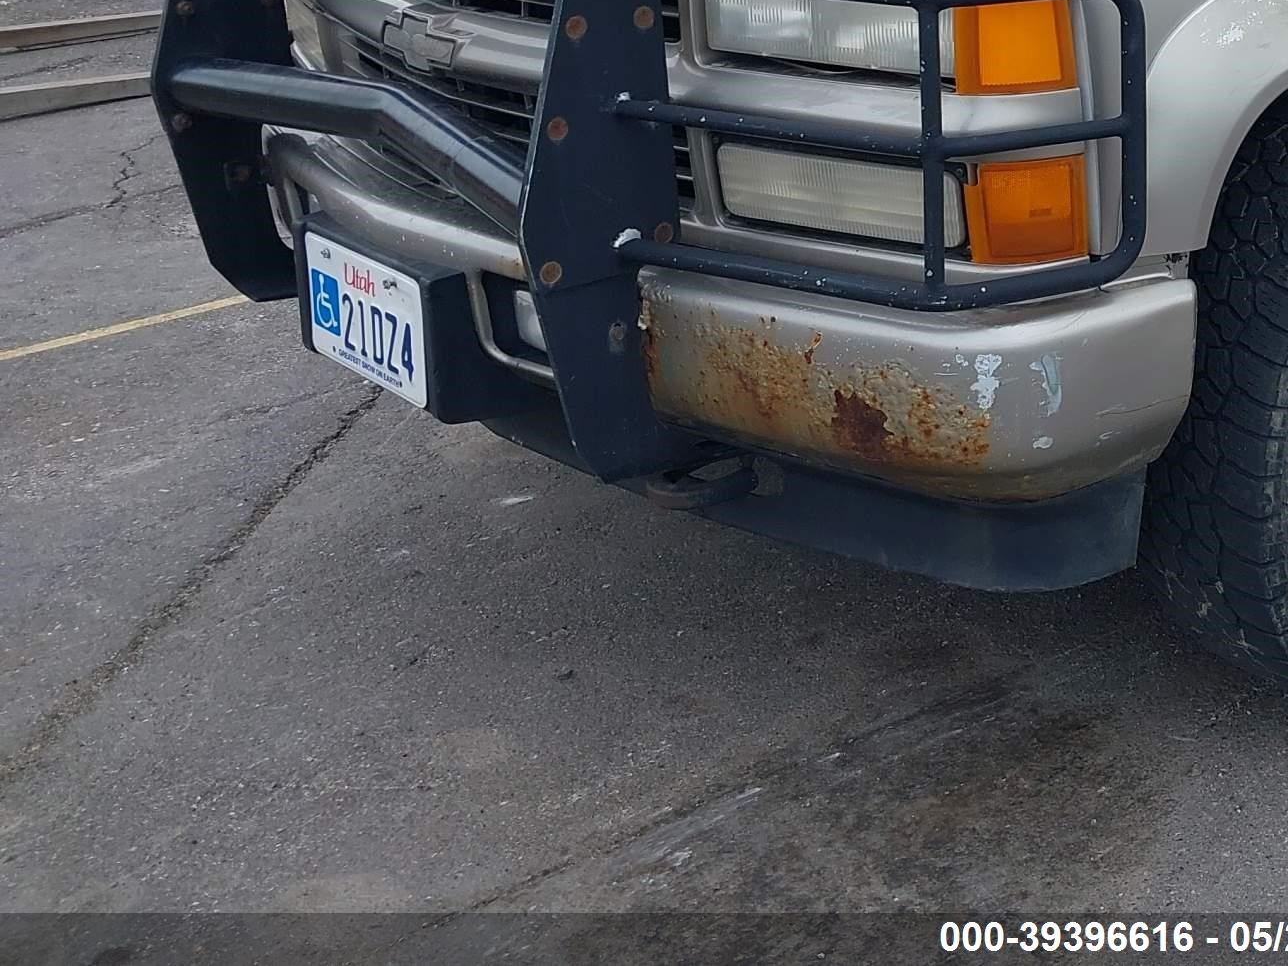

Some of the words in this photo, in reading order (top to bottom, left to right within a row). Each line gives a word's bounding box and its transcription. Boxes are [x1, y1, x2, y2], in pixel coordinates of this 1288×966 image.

[344, 262, 376, 297] Utah
[342, 292, 414, 383] 21DZ4
[338, 348, 361, 366] GREATEST
[361, 360, 376, 374] SNOW
[375, 369, 383, 379] ON
[383, 372, 401, 388] EARTH
